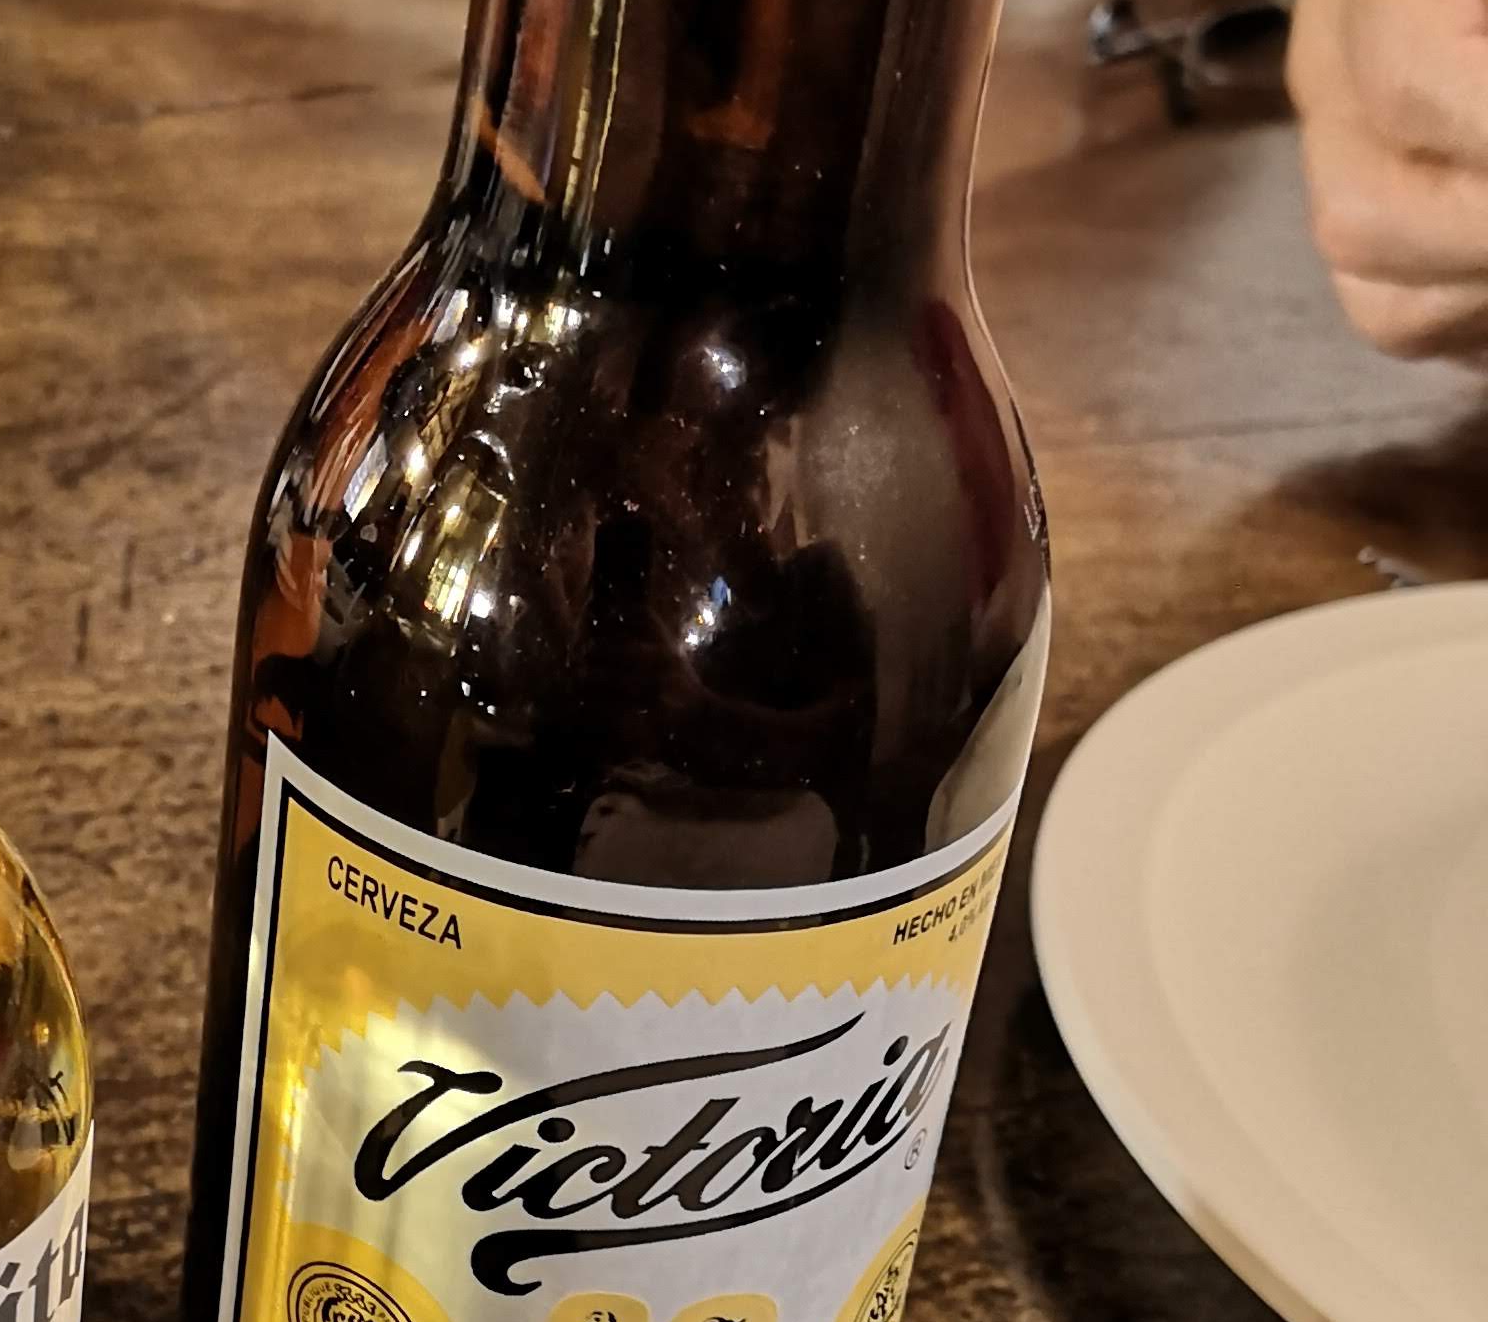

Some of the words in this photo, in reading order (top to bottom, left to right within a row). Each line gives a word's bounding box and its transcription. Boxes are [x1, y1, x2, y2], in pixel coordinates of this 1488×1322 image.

[327, 855, 463, 950] CERVEZA
[892, 895, 957, 946] HECHO
[354, 1011, 952, 1296] Victoria
